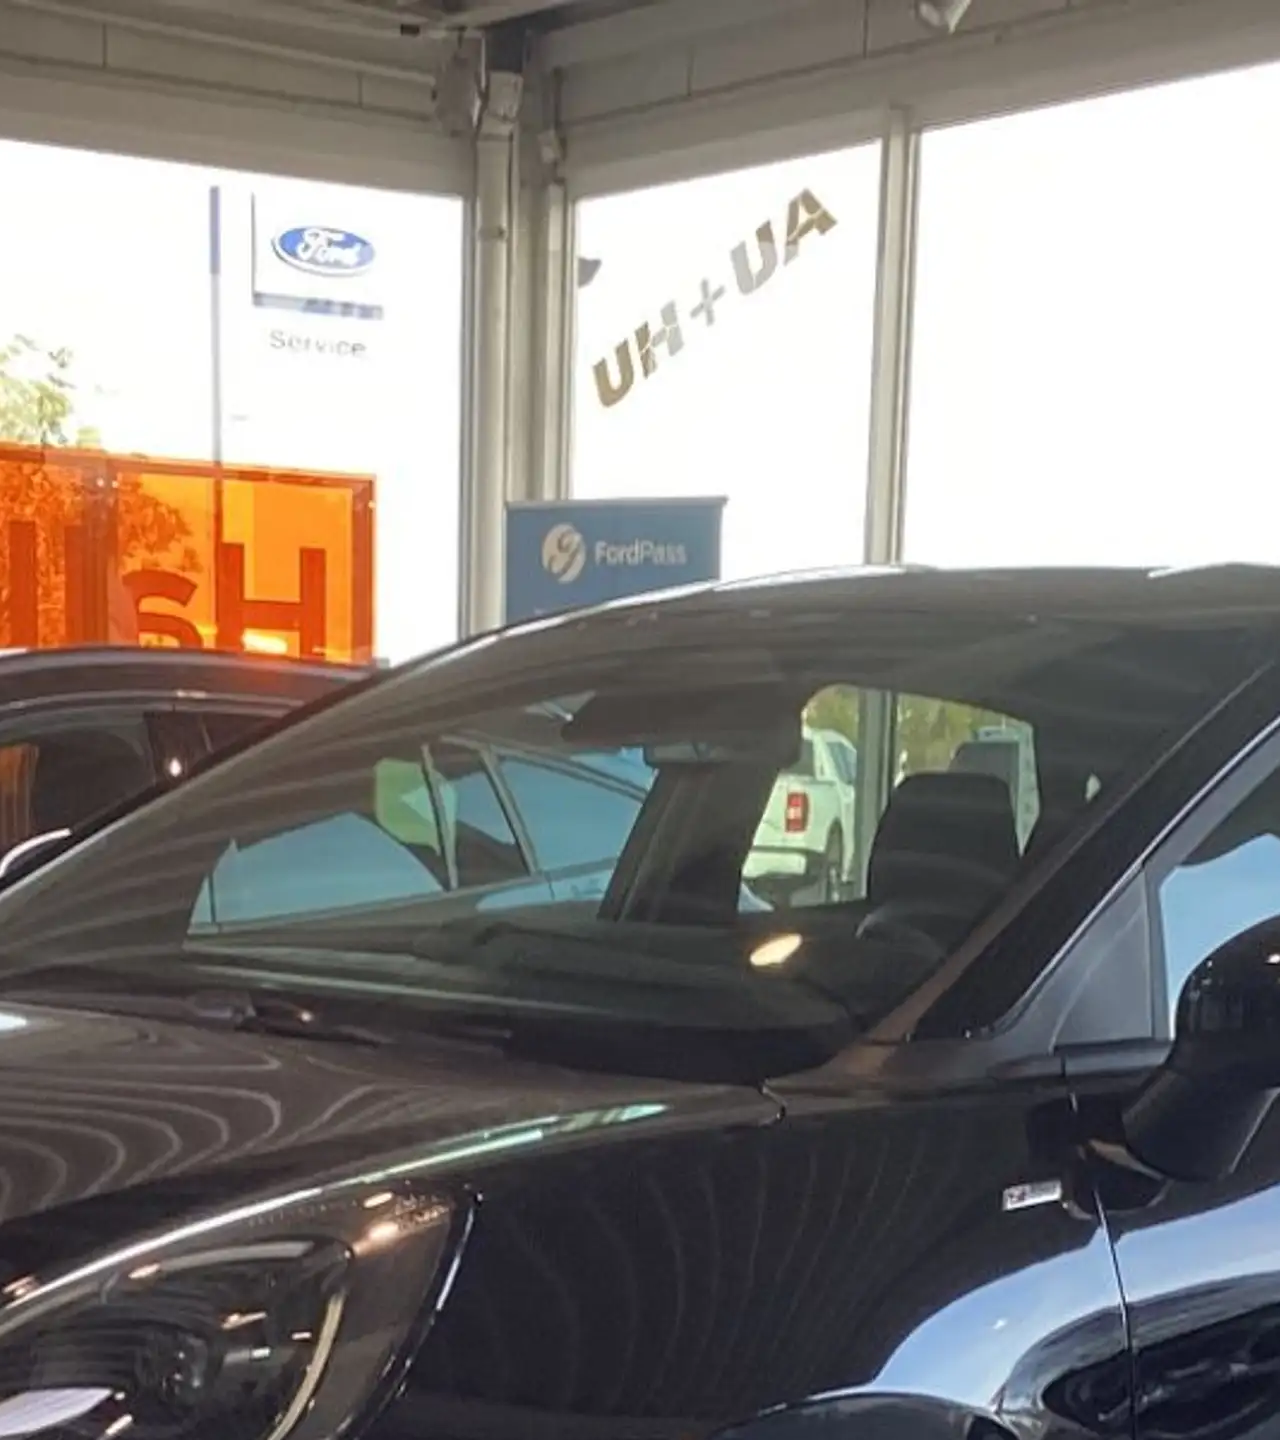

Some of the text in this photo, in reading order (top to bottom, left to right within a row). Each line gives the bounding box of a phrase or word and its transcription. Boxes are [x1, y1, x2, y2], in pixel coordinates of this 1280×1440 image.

[296, 228, 362, 266] Ford
[269, 330, 367, 356] Service
[594, 538, 688, 567] FordPass
